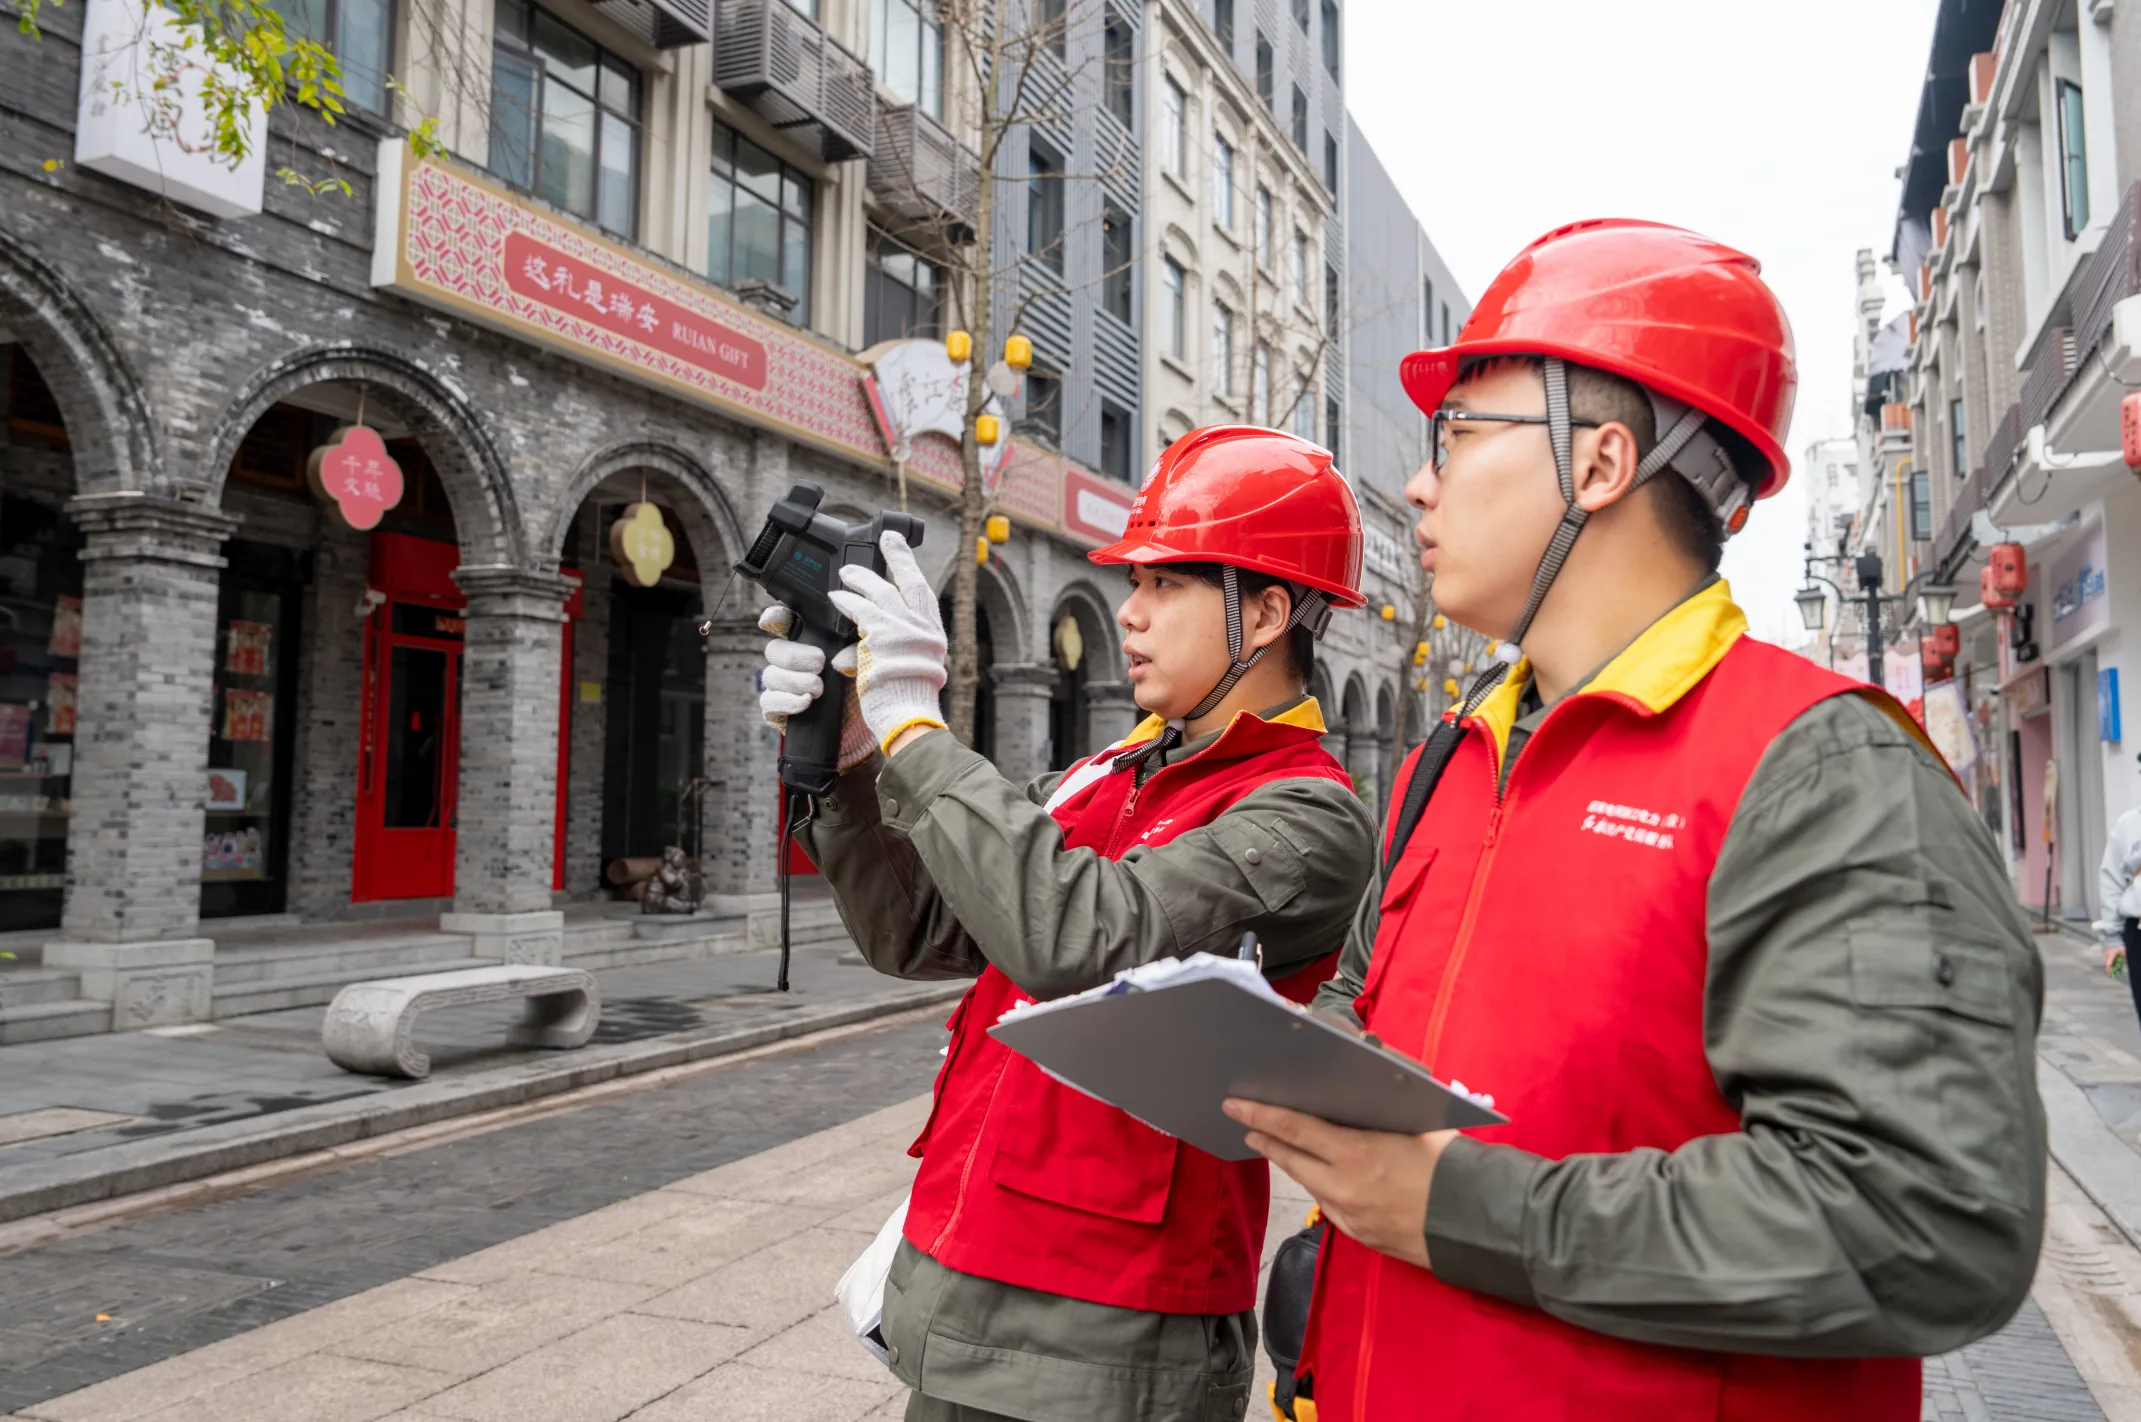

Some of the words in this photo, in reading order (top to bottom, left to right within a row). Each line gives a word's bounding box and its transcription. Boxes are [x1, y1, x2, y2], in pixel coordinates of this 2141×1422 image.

[523, 254, 660, 333] 这礼是瑞安
[671, 321, 718, 356] RUIAN
[718, 342, 750, 370] GIFT
